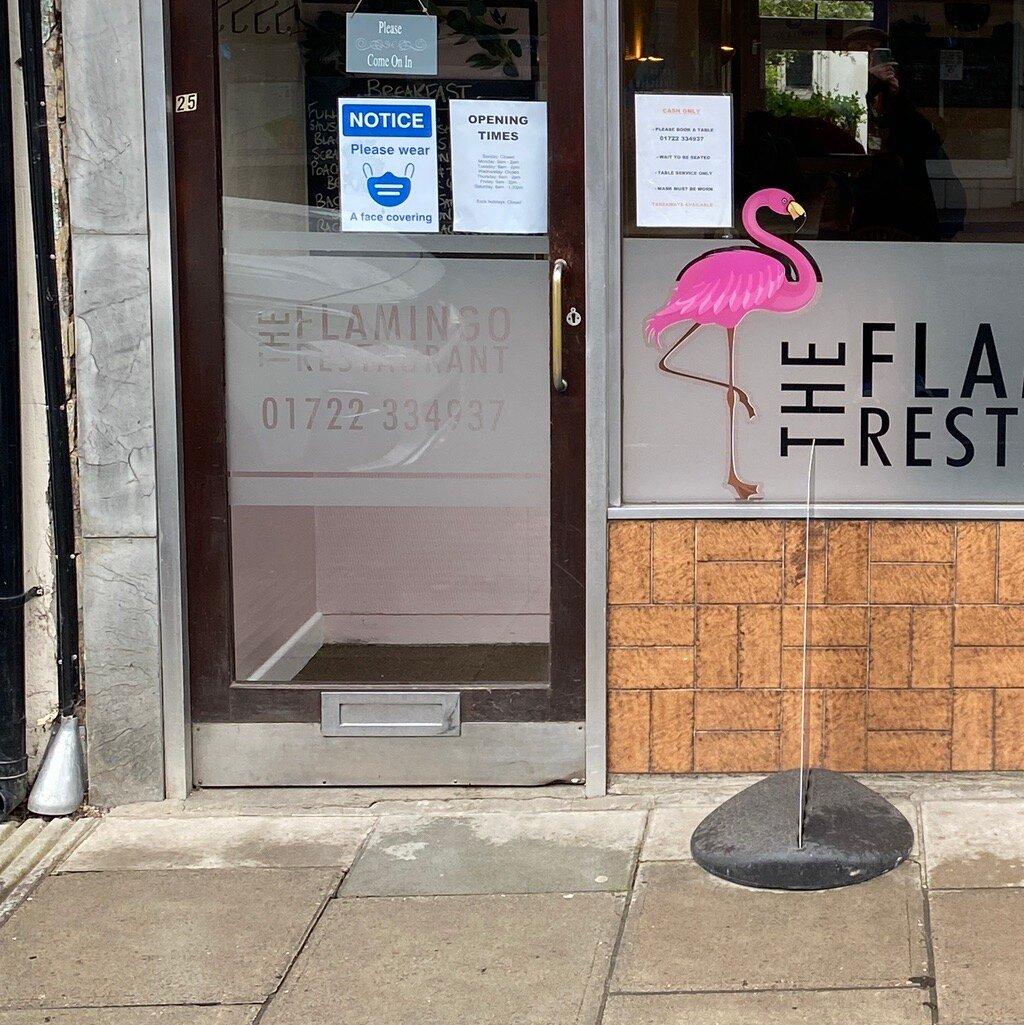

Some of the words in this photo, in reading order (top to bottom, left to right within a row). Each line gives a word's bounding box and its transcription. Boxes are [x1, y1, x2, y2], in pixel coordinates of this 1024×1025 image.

[378, 21, 403, 35] Please
[367, 53, 390, 68] Come
[391, 54, 403, 69] On
[405, 55, 413, 69] In
[176, 94, 196, 112] 25
[349, 112, 425, 129] NOTICE
[468, 114, 528, 125] OPENING
[314, 132, 338, 146] BLA
[478, 131, 519, 141] TIMES
[312, 146, 339, 160] SCRA
[351, 144, 395, 155] Please
[398, 146, 431, 156] wear
[350, 212, 358, 221] A
[361, 212, 384, 222] face
[386, 212, 433, 224] covering
[296, 303, 513, 342] FLAMINGO
[257, 311, 290, 367] THE
[780, 341, 846, 457] THE
[262, 396, 364, 430] 01722
[382, 397, 506, 432] 334937
